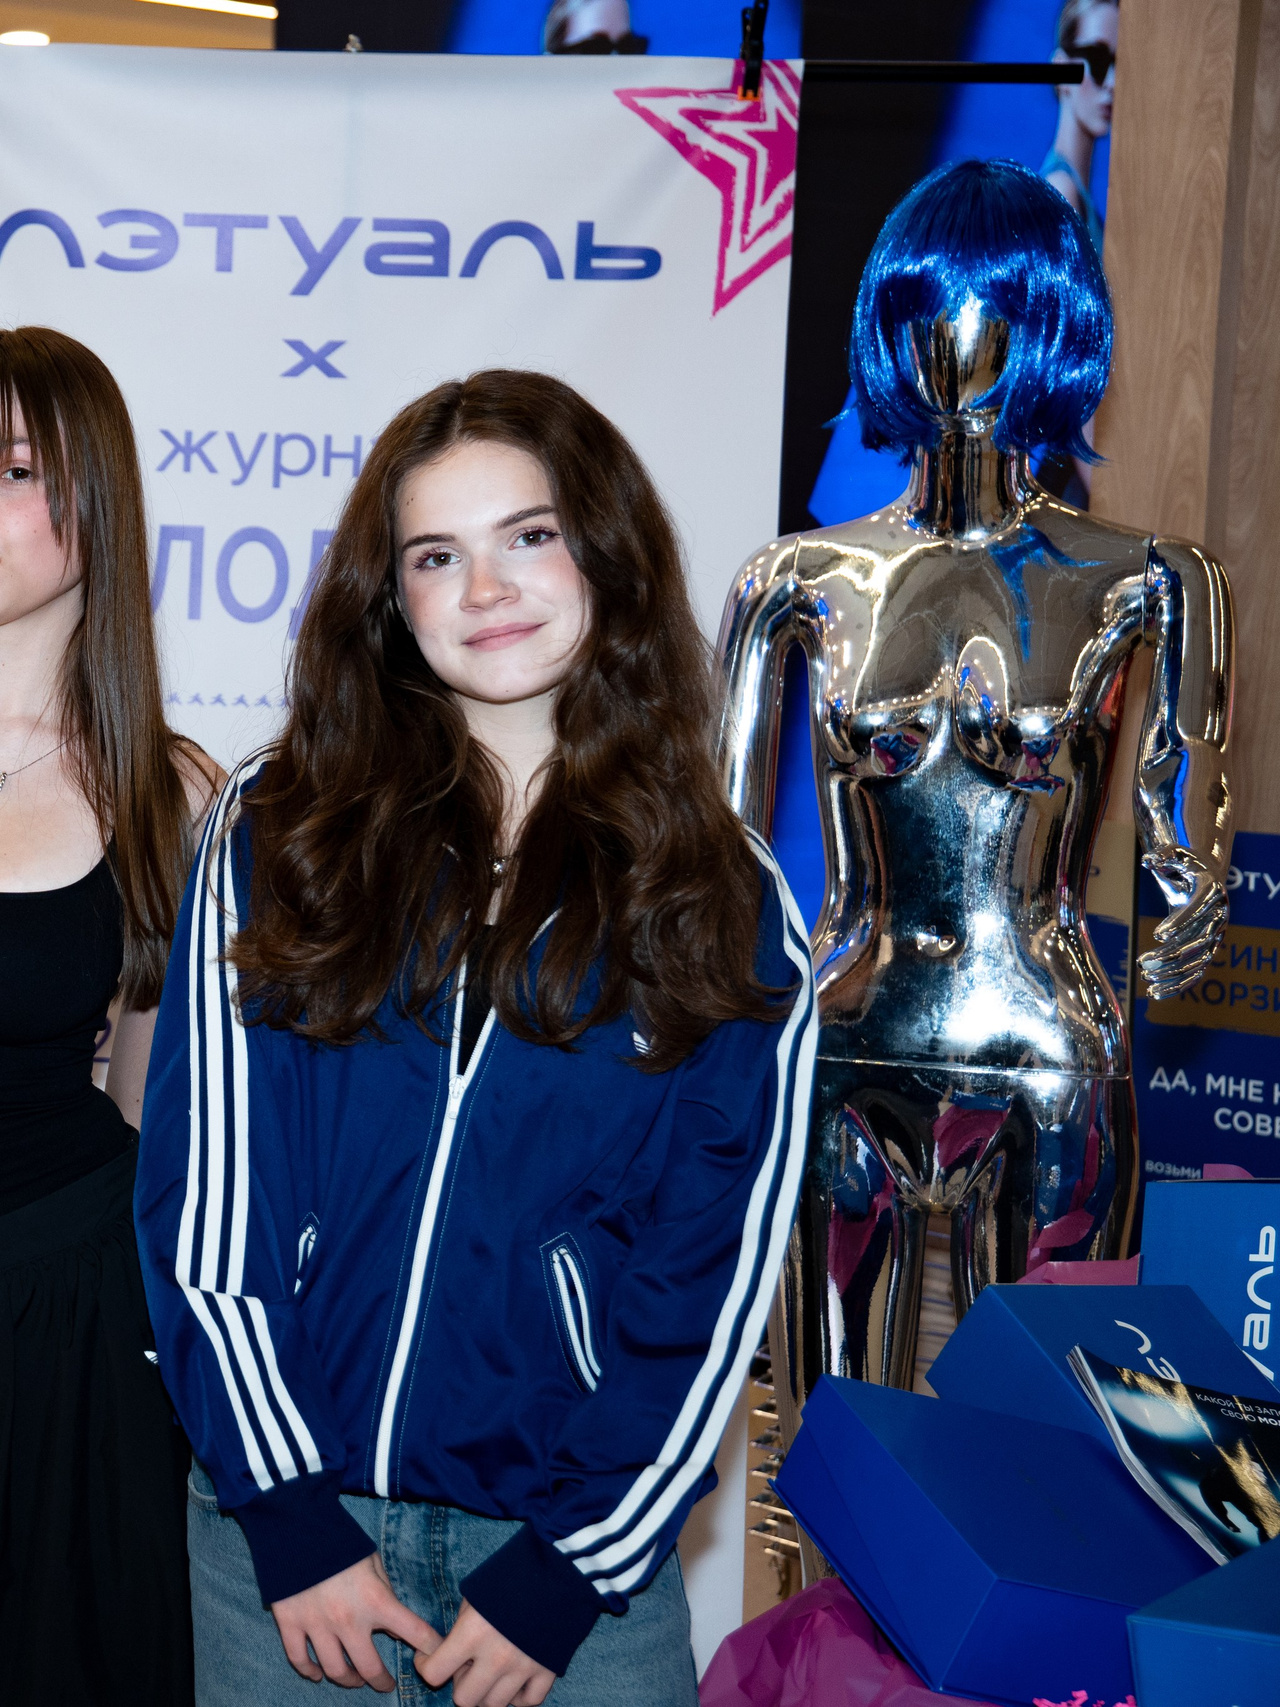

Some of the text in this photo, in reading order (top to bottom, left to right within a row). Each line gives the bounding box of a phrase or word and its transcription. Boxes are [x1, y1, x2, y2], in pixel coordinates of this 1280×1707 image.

[155, 429, 379, 489] журн
[1149, 1066, 1197, 1096] ДА,
[1205, 1072, 1264, 1104] МНЕ
[1144, 1159, 1202, 1180] ВОЗЬМИ
[1195, 1393, 1235, 1409] КАКОЙ
[1235, 1402, 1254, 1412] ТЫ
[1220, 1408, 1280, 1427] СВОЮ МО
